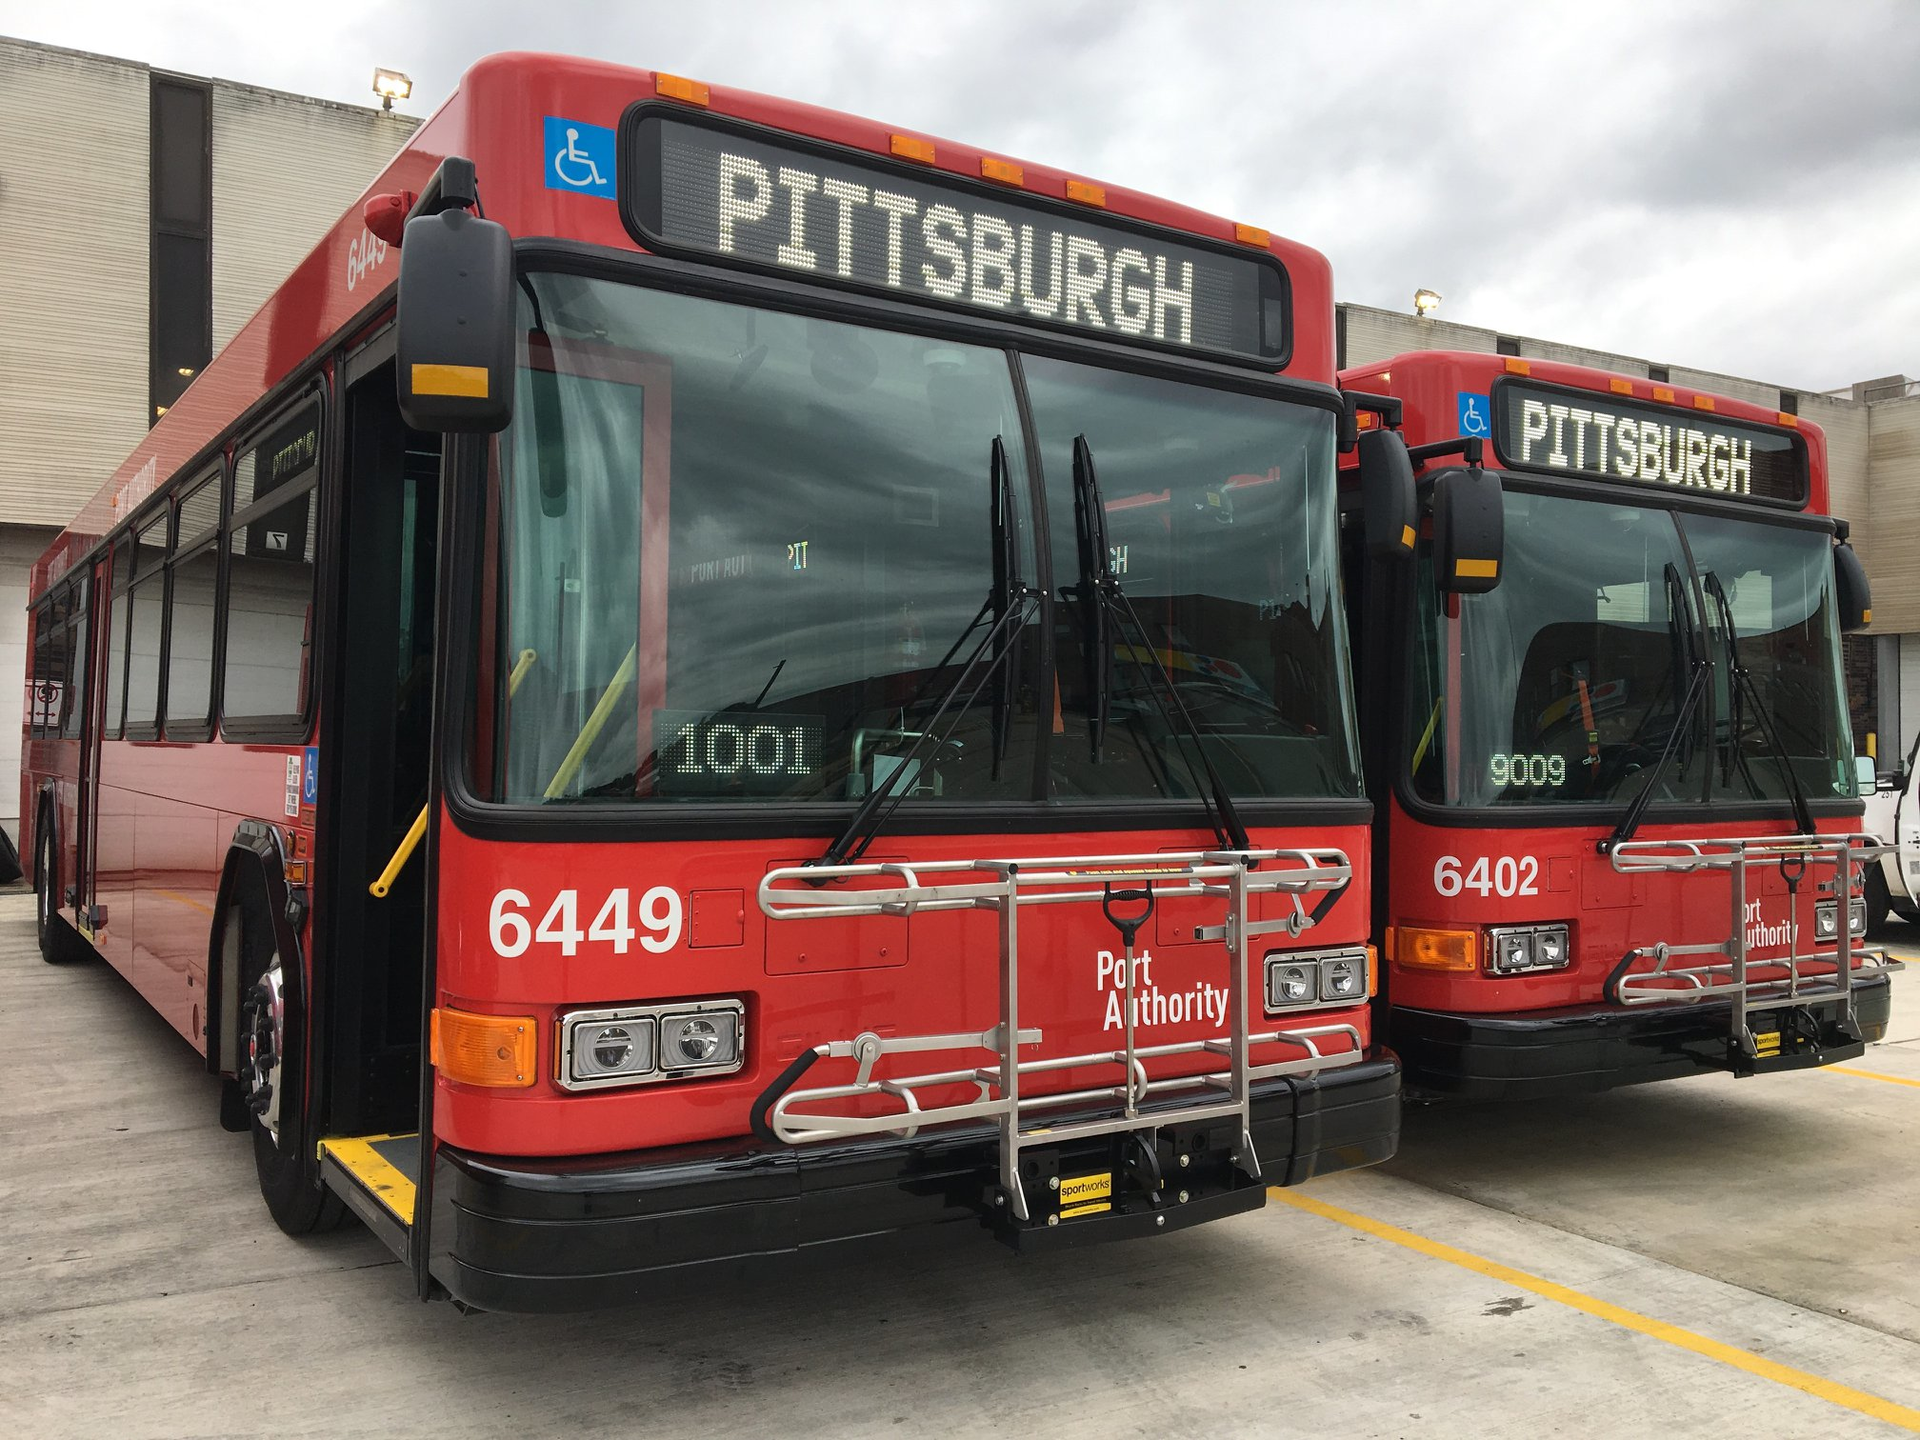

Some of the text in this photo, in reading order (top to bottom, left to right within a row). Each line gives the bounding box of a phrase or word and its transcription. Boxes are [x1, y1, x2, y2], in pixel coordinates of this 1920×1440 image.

[719, 152, 1193, 344] PITTSBURGH
[1523, 399, 1751, 495] PITTSBURGH
[677, 723, 811, 774] 1001
[1490, 753, 1566, 786] 9009
[1433, 855, 1539, 897] 6402
[488, 885, 683, 958] 6449
[1744, 898, 1761, 923] ort
[1097, 950, 1152, 991] Port
[1103, 981, 1229, 1032] Authority
[1061, 1179, 1110, 1197] sportworks
